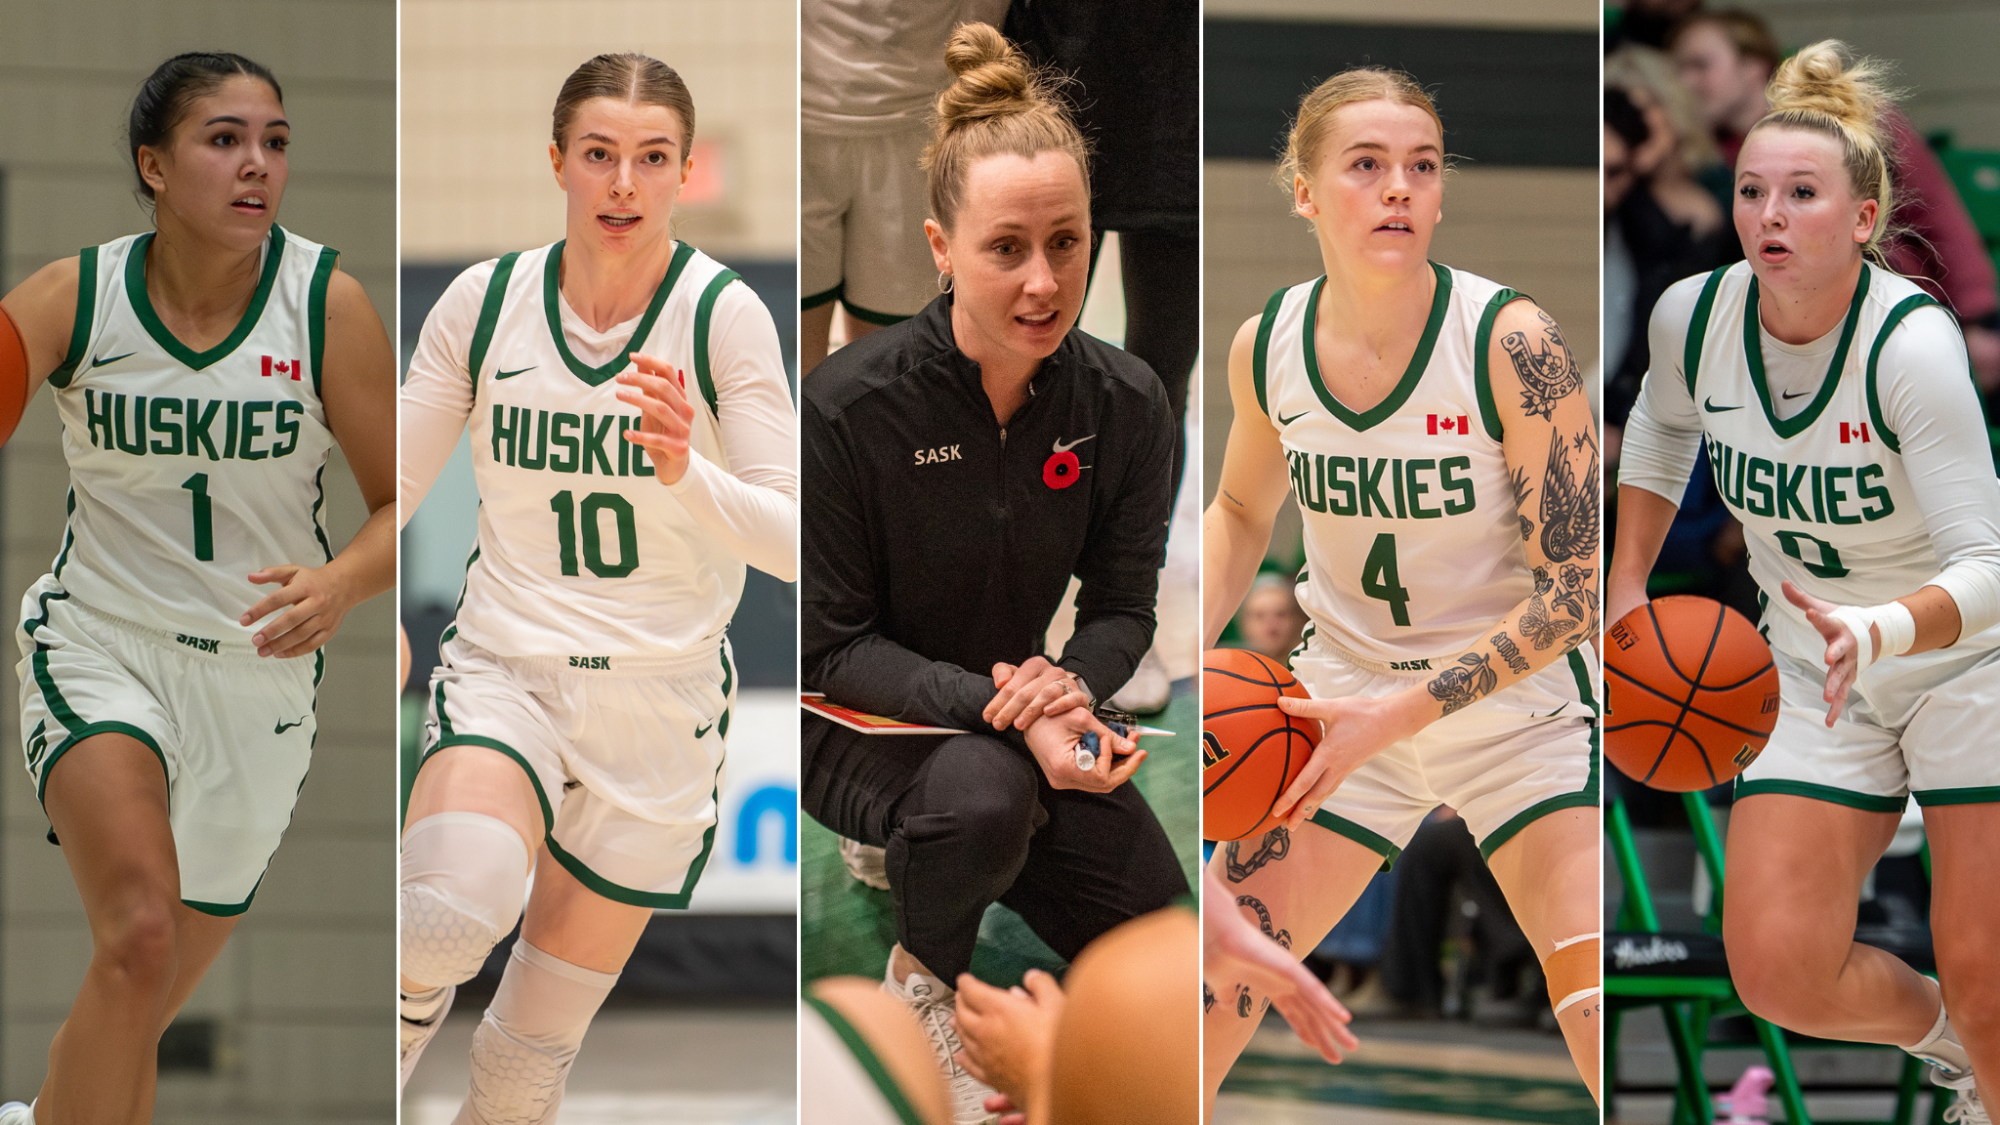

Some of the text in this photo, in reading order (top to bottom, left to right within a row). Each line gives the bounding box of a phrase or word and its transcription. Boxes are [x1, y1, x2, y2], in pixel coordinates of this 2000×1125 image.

[85, 388, 304, 461] HUSKIES
[491, 403, 656, 477] HUSKIE
[914, 444, 963, 466] SASK
[1286, 449, 1476, 519] HUSKIES
[1708, 431, 1895, 525] HUSKIES
[181, 472, 214, 562] 1
[550, 490, 640, 578] 10
[1361, 533, 1412, 626] 4
[1773, 530, 1852, 578] 0
[176, 633, 221, 655] SASK
[569, 656, 611, 671] SASK
[1390, 658, 1433, 671] SASK
